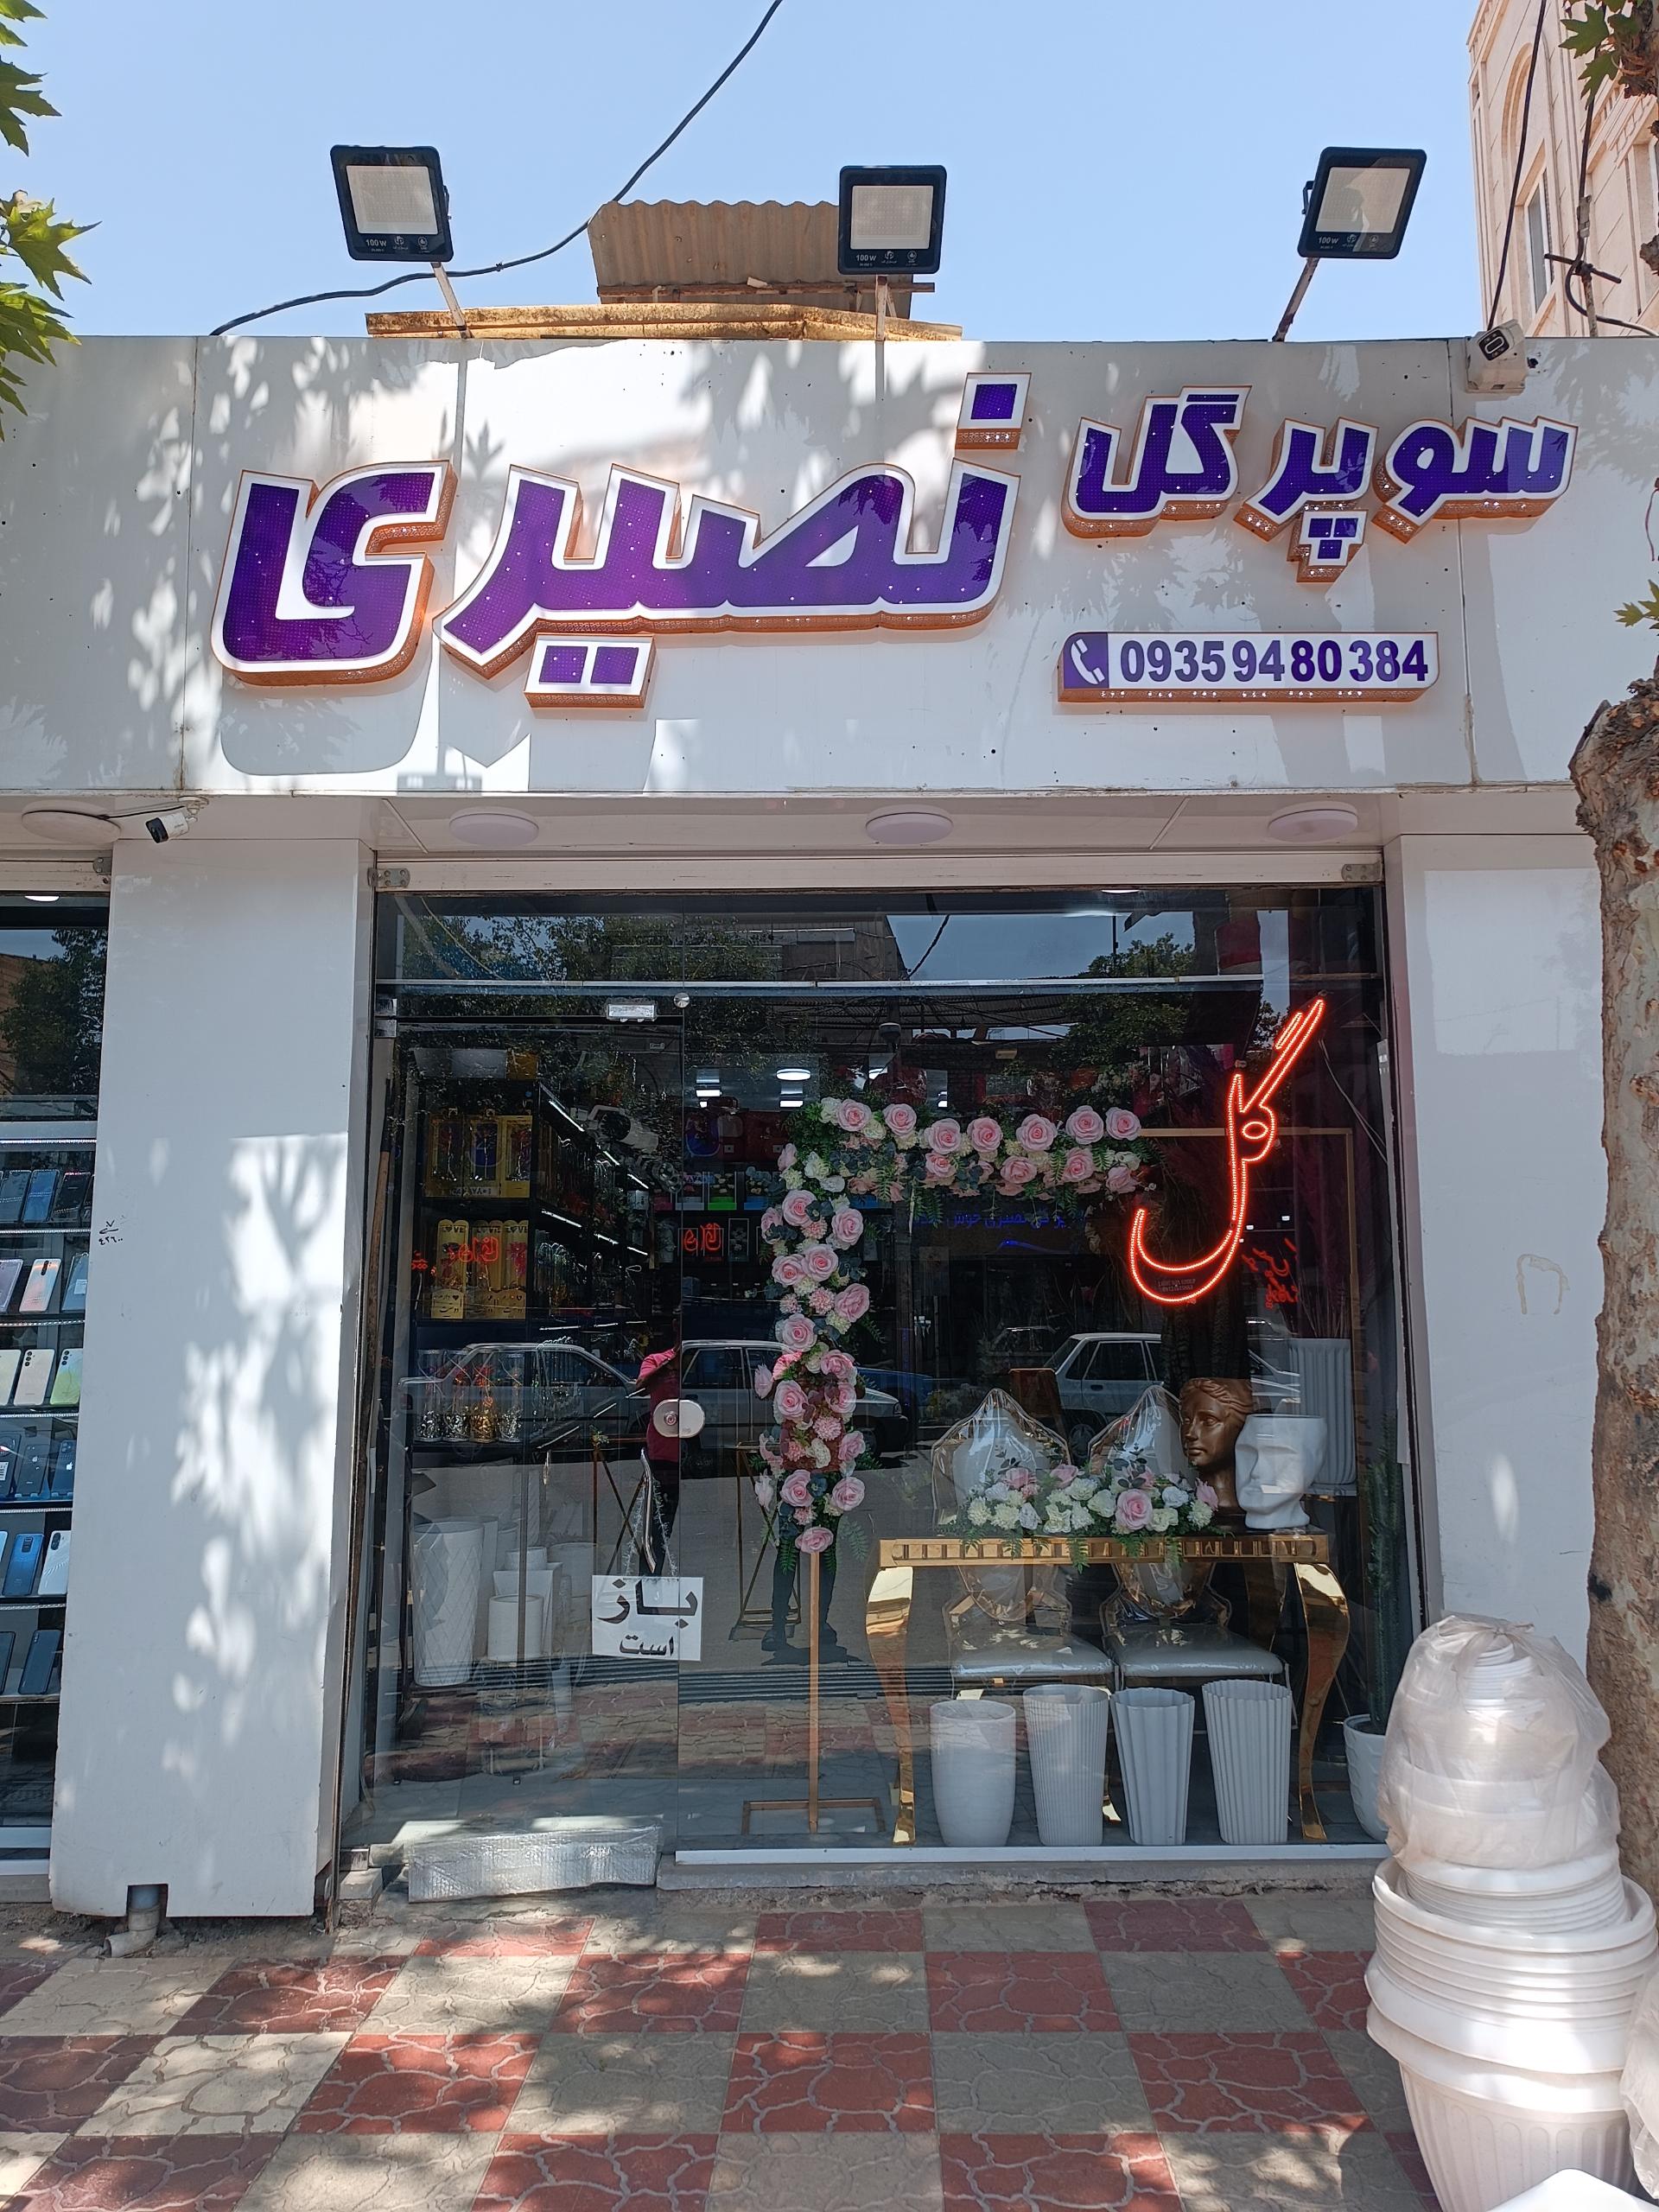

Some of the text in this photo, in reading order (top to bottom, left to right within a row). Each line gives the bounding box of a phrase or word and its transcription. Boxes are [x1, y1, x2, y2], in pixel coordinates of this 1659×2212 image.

[212, 372, 1031, 696] نصیری
[1067, 385, 1578, 567] سوپر گل
[596, 1579, 698, 1629] باز
[619, 1635, 675, 1657] است
